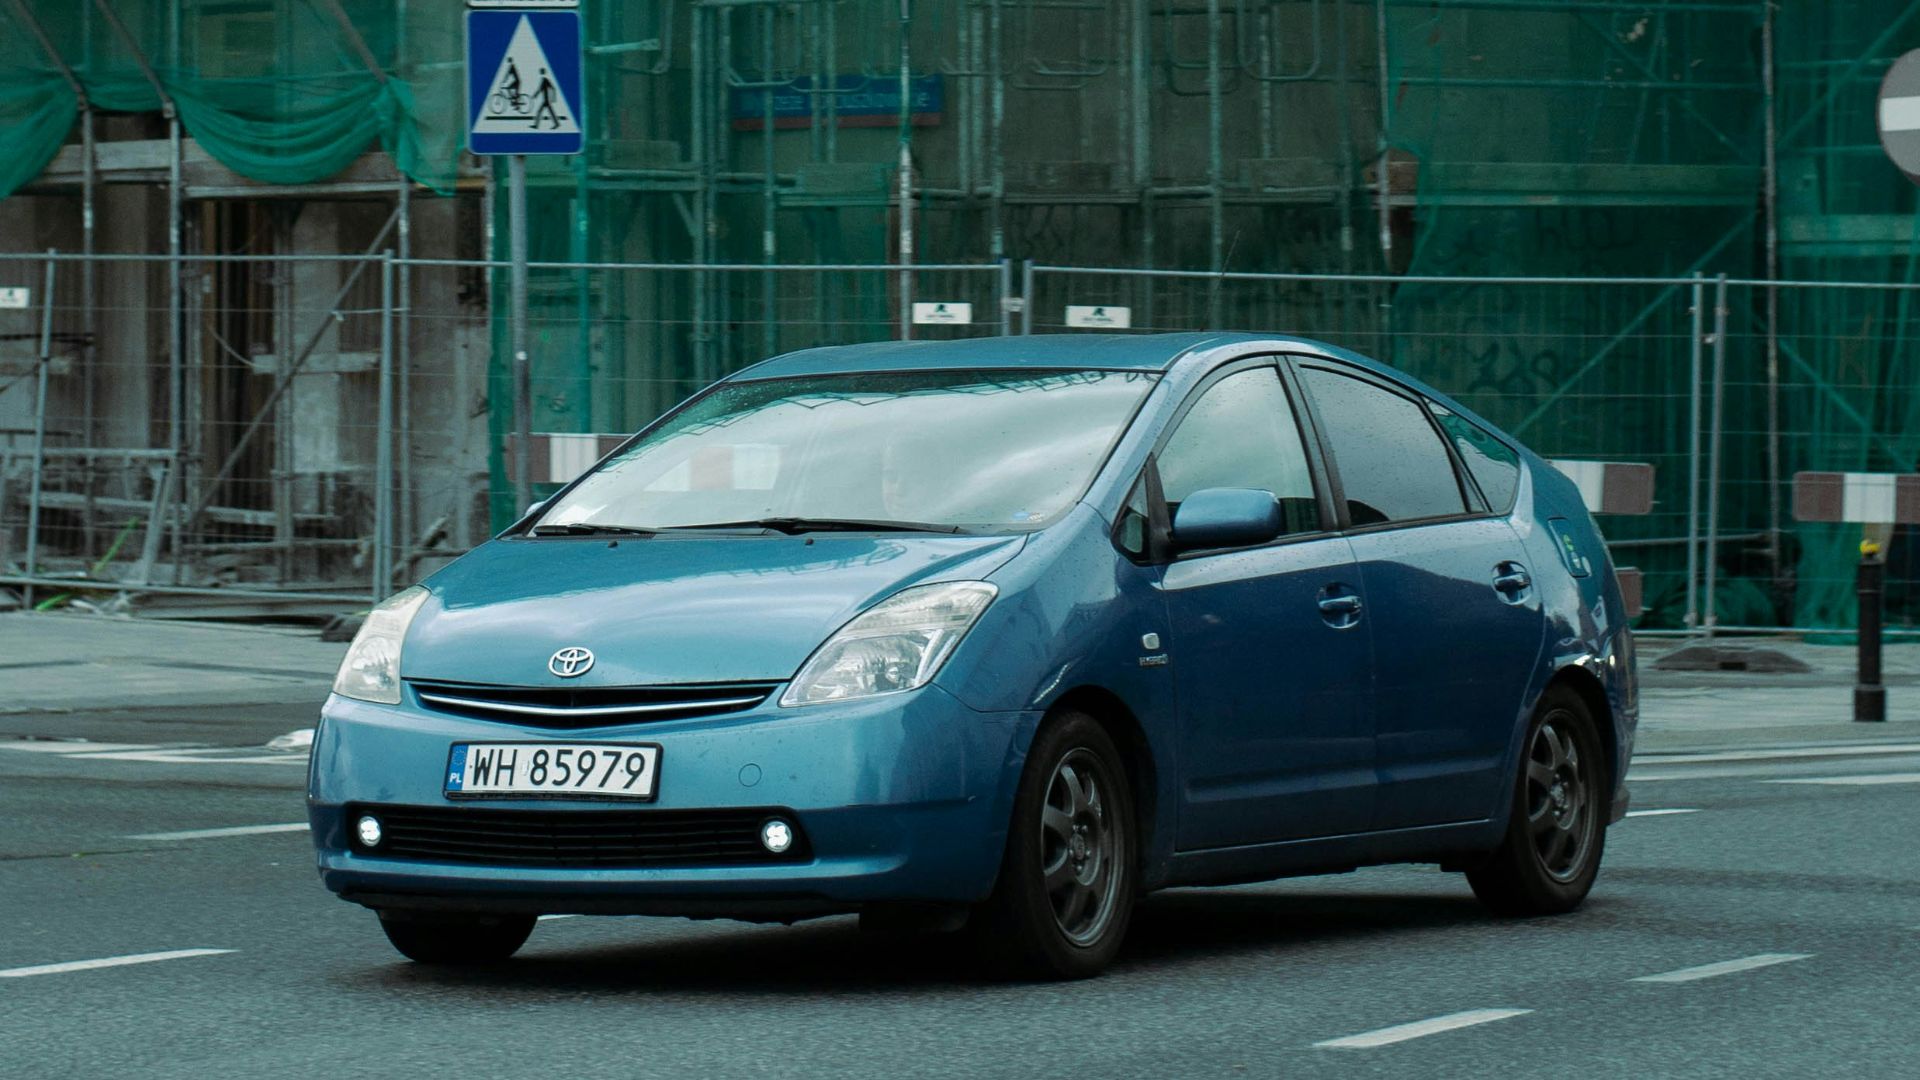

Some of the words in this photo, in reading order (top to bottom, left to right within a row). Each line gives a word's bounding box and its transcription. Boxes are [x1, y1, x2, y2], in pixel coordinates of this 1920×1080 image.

[449, 772, 462, 783] PL
[473, 748, 518, 786] WH
[530, 748, 645, 789] 85979
